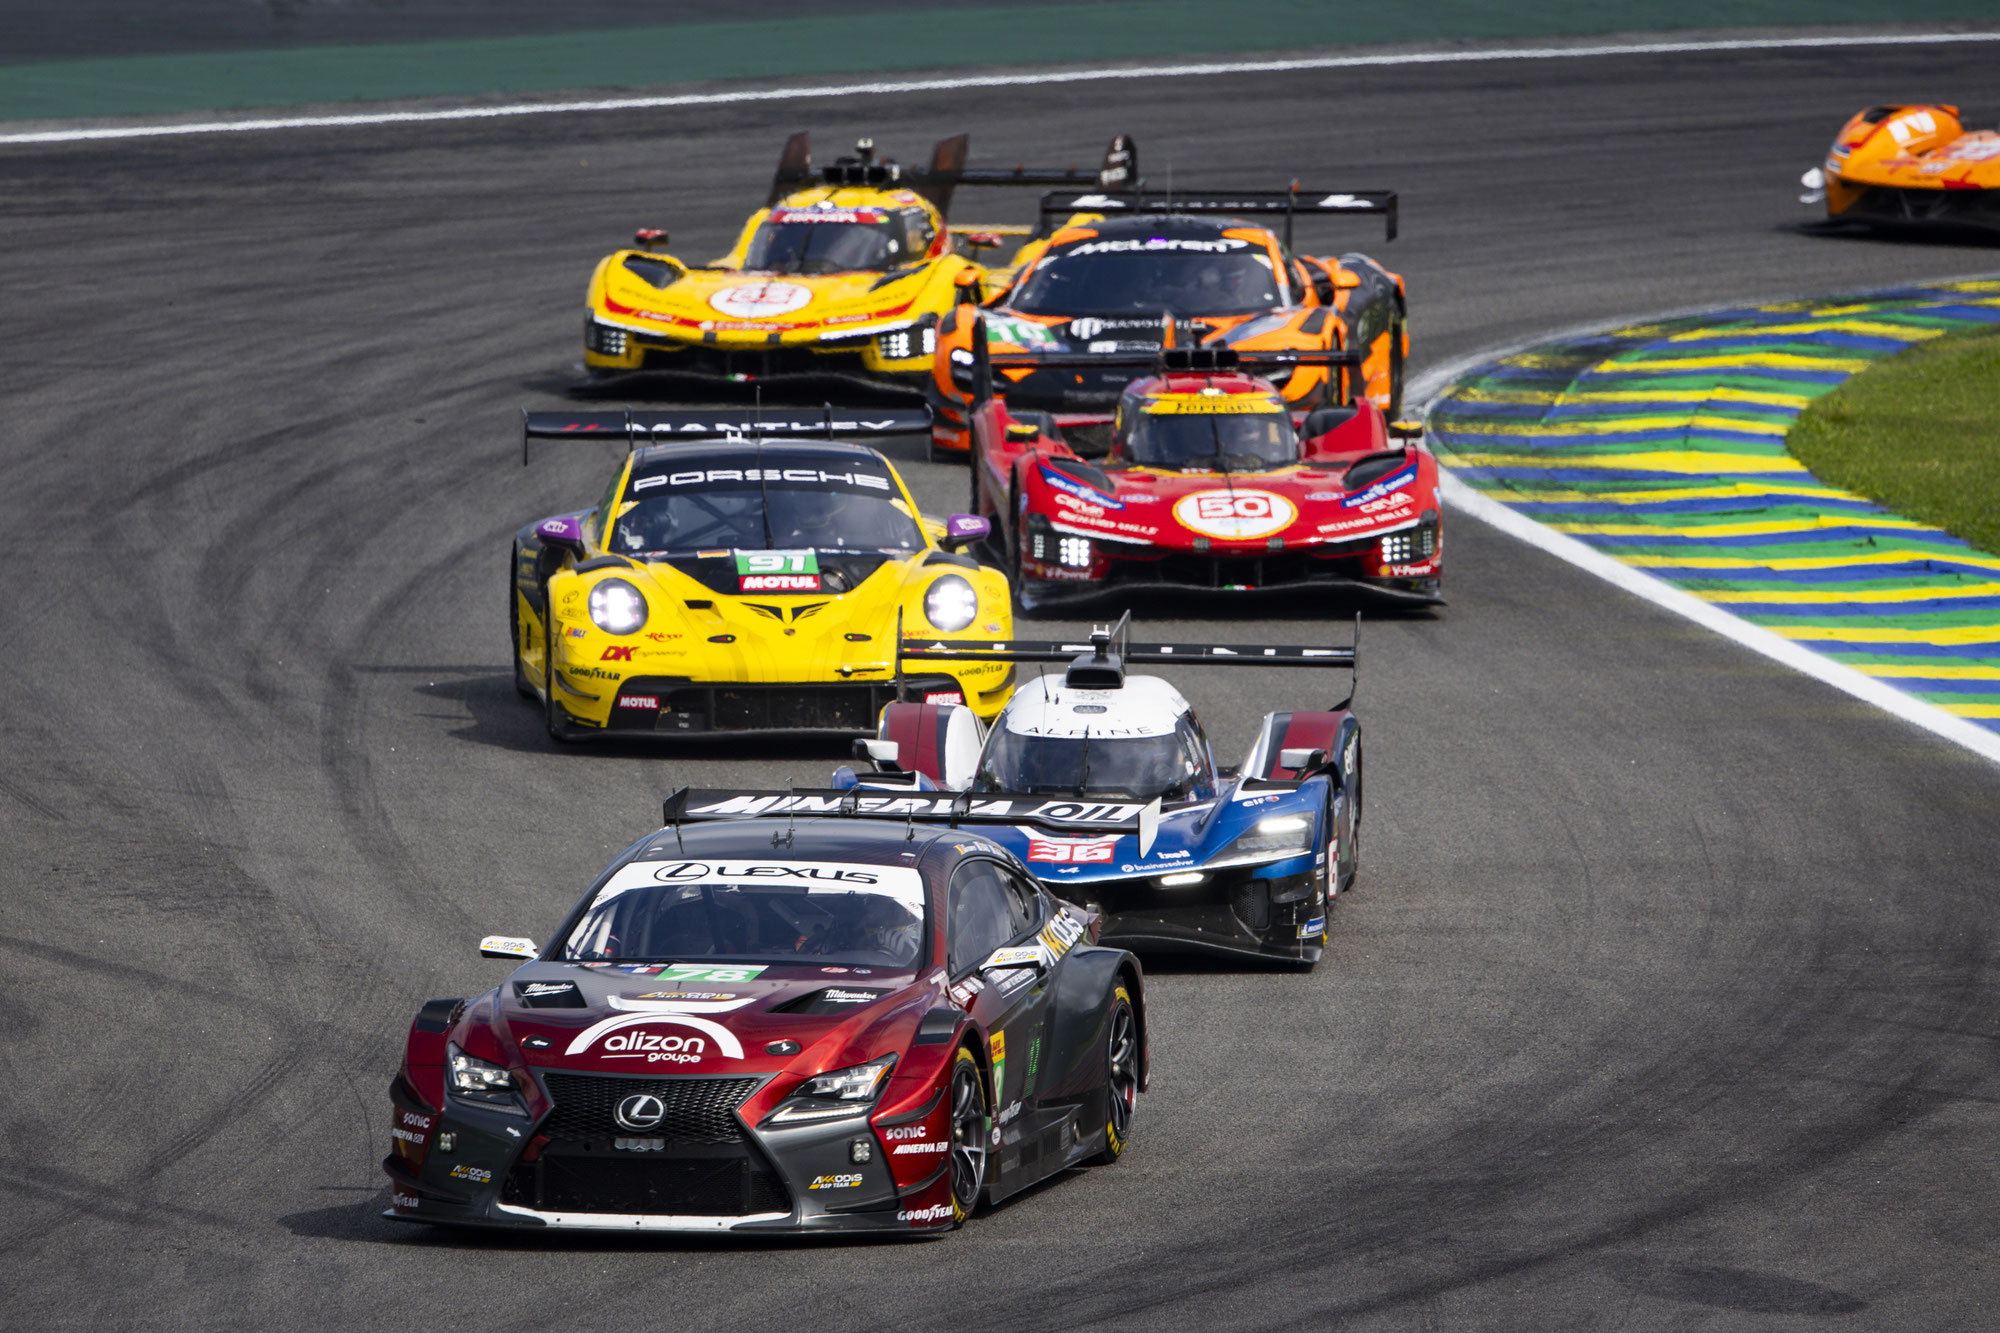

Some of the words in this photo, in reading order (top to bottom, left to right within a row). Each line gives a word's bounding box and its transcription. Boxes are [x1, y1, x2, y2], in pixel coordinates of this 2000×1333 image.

[633, 469, 891, 492] PORSCHE
[1198, 498, 1269, 517] 50
[748, 556, 806, 572] 91
[743, 577, 818, 590] MOTUL
[600, 646, 640, 662] DK
[620, 697, 657, 709] MOTUL
[1024, 726, 1154, 738] ALPINE
[686, 795, 1015, 816] MINERVA
[1042, 803, 1124, 821] OIL
[716, 865, 880, 891] LEXUS
[665, 968, 750, 982] 78
[525, 982, 575, 994] Milwaukee
[824, 988, 878, 1000] Milwaukee
[603, 1030, 706, 1054] alizon
[647, 1051, 702, 1064] groupe
[892, 1143, 936, 1155] MINERVA
